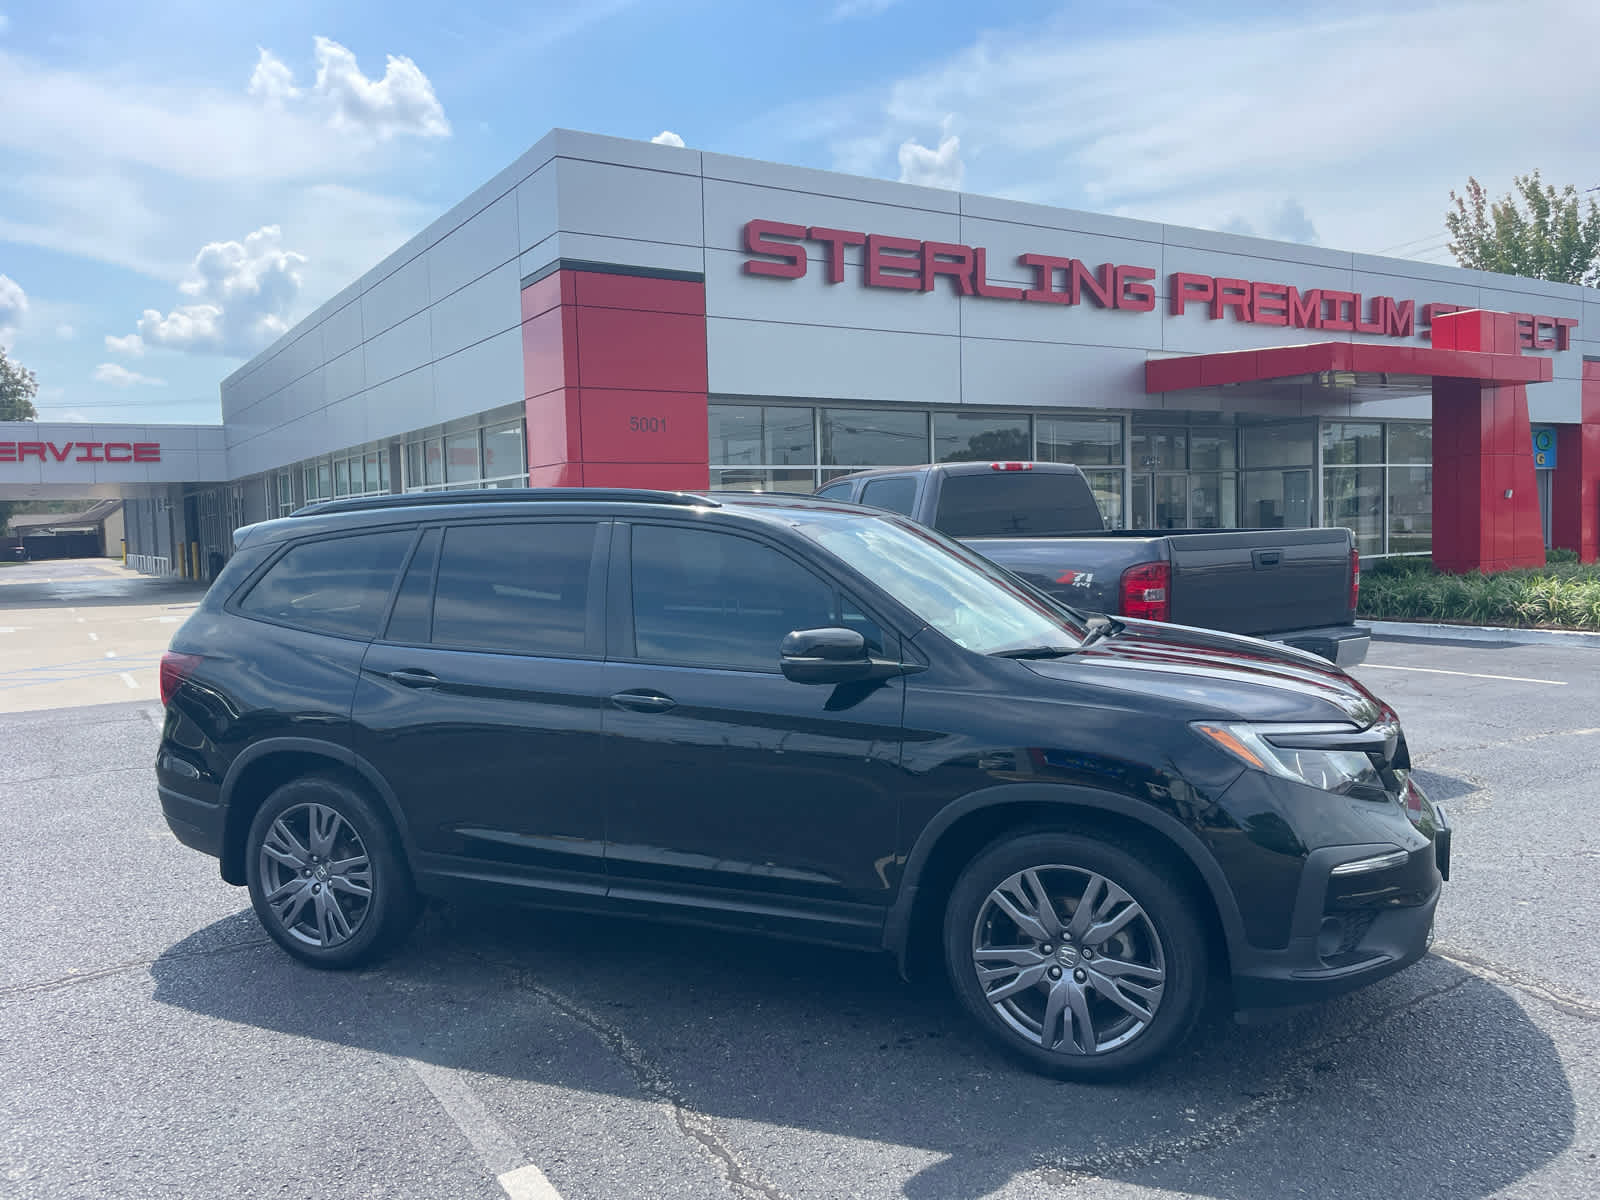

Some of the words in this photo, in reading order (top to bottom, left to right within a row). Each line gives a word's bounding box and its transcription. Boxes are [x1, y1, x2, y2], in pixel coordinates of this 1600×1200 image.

[743, 218, 1156, 313] STERLING
[1169, 271, 1416, 338] PREMIUM
[629, 416, 667, 433] 5001
[0, 441, 161, 463] ERVICE
